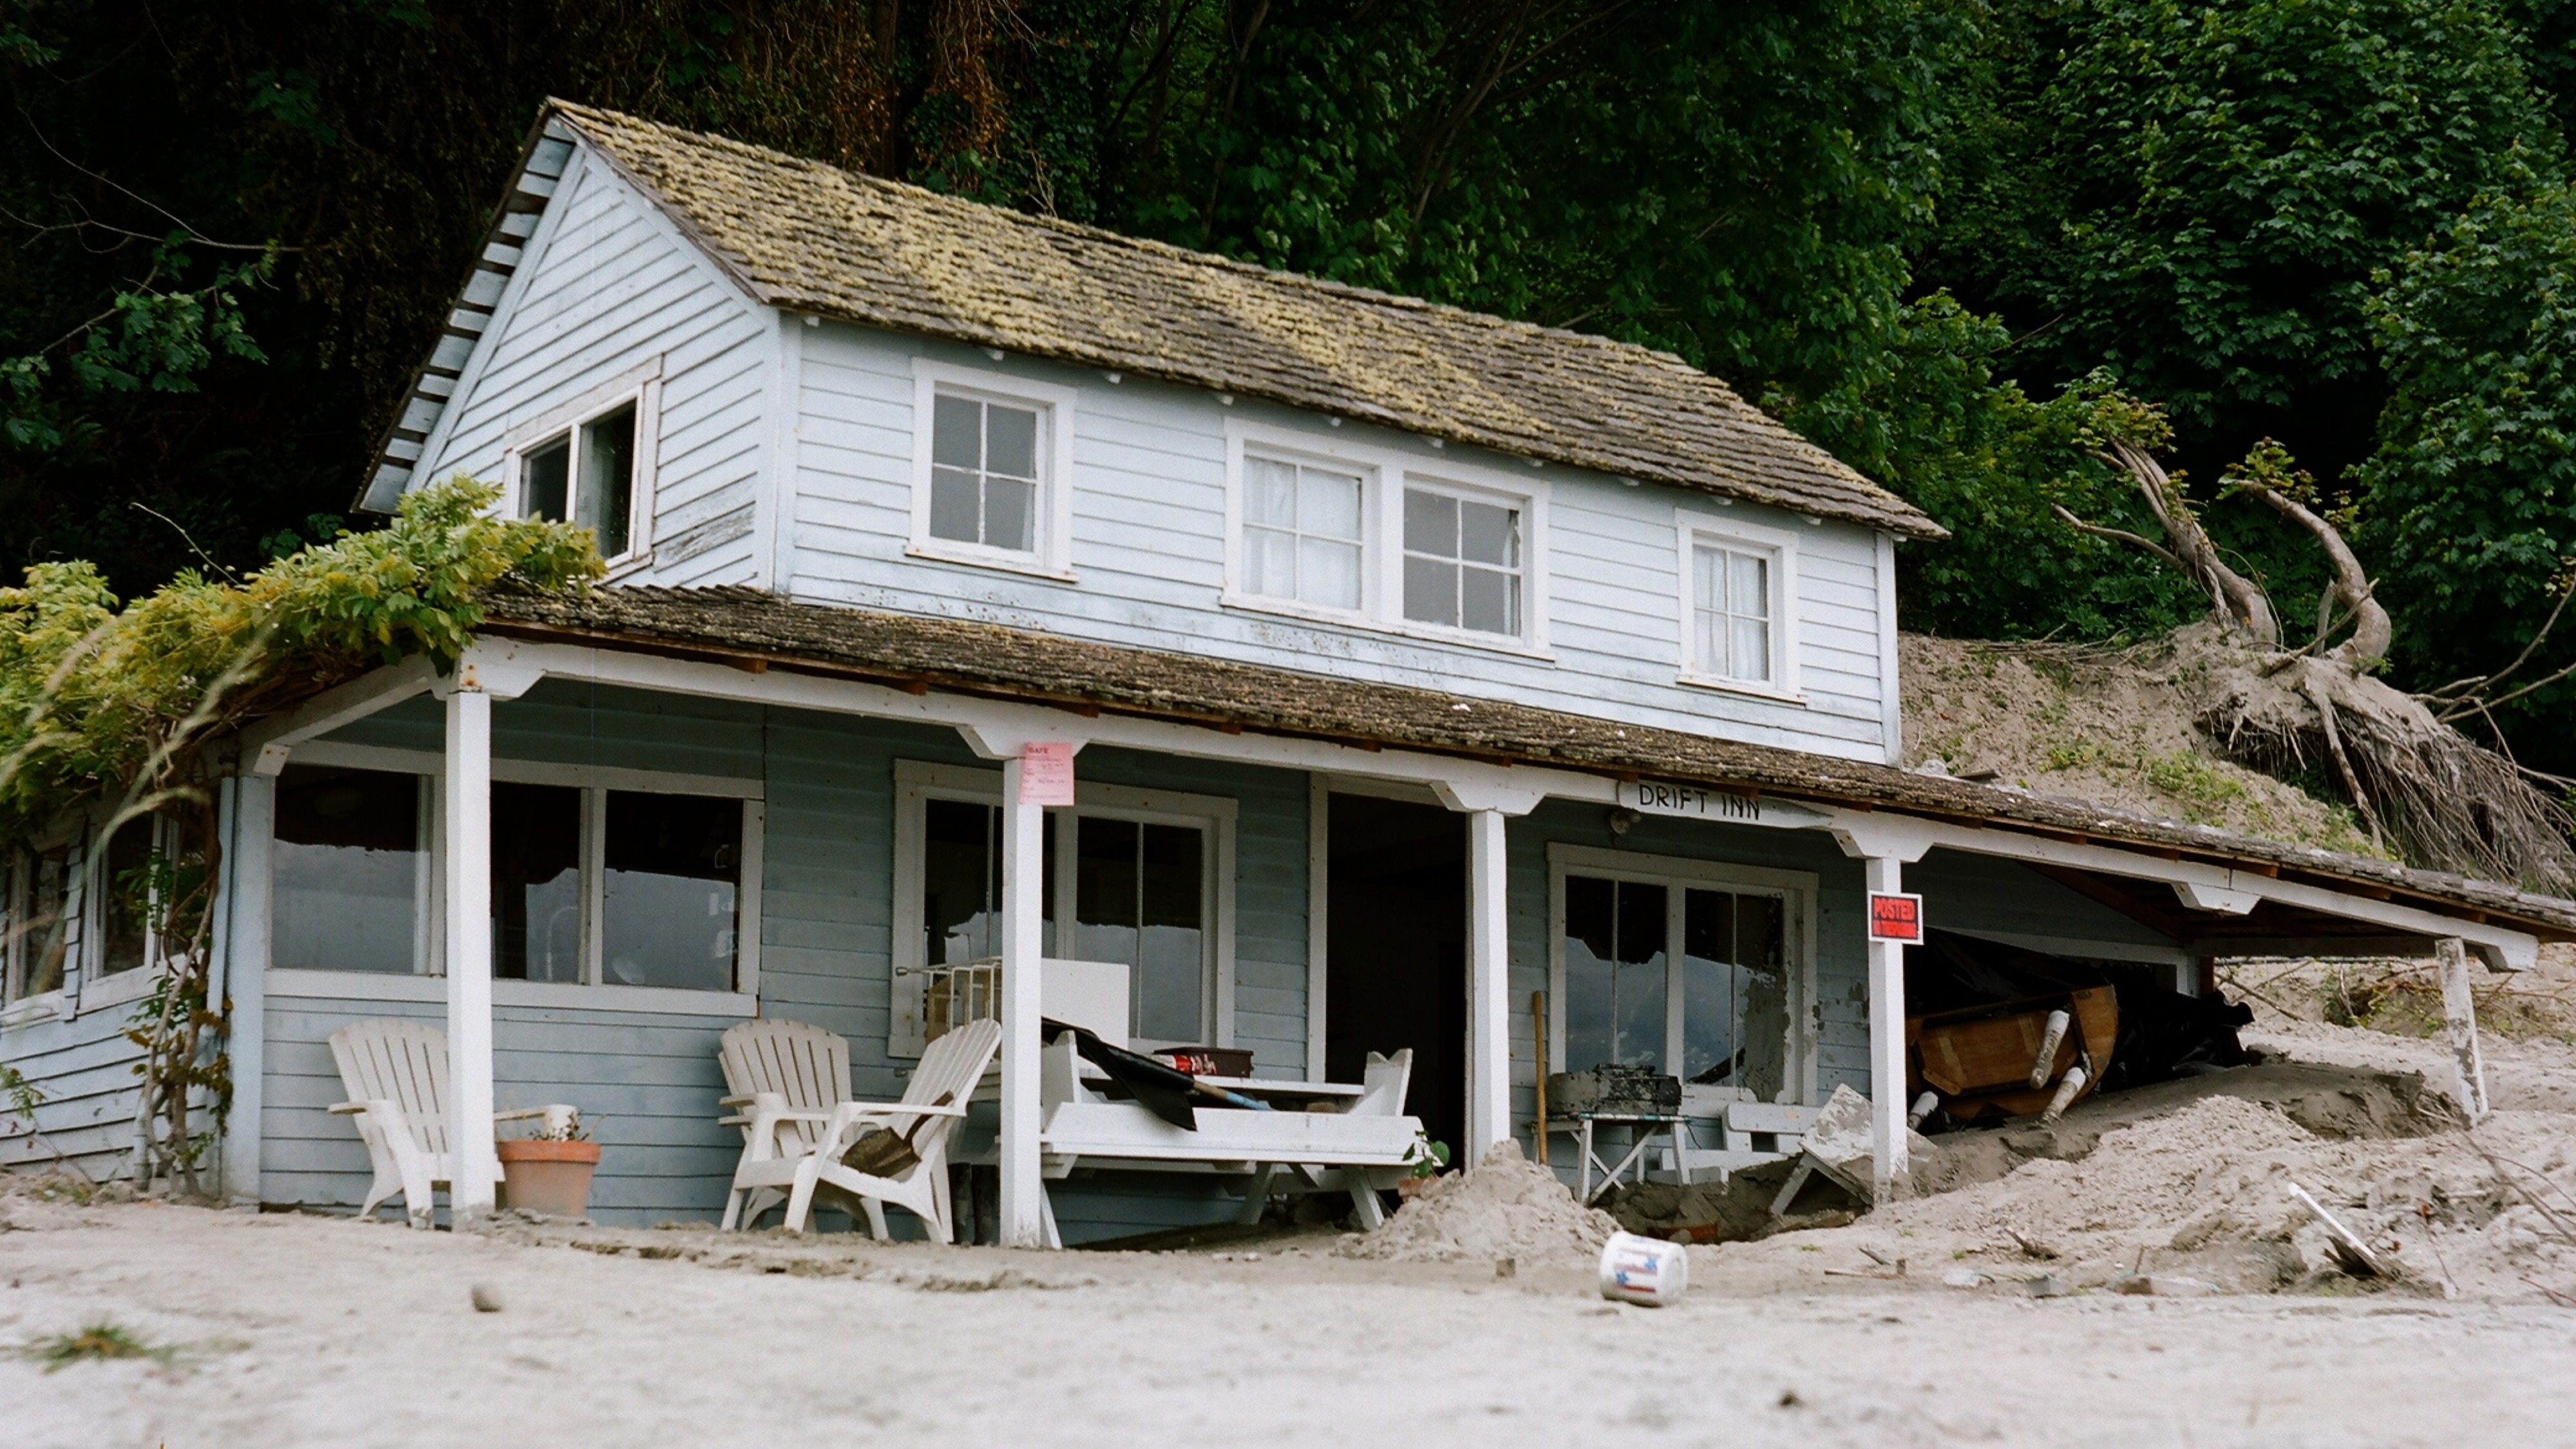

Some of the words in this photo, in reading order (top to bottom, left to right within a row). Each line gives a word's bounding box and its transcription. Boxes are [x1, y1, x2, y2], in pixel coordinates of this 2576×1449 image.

[1638, 784, 1709, 813] DRIFT
[1722, 794, 1761, 820] INN
[1873, 896, 1916, 921] POSTED
